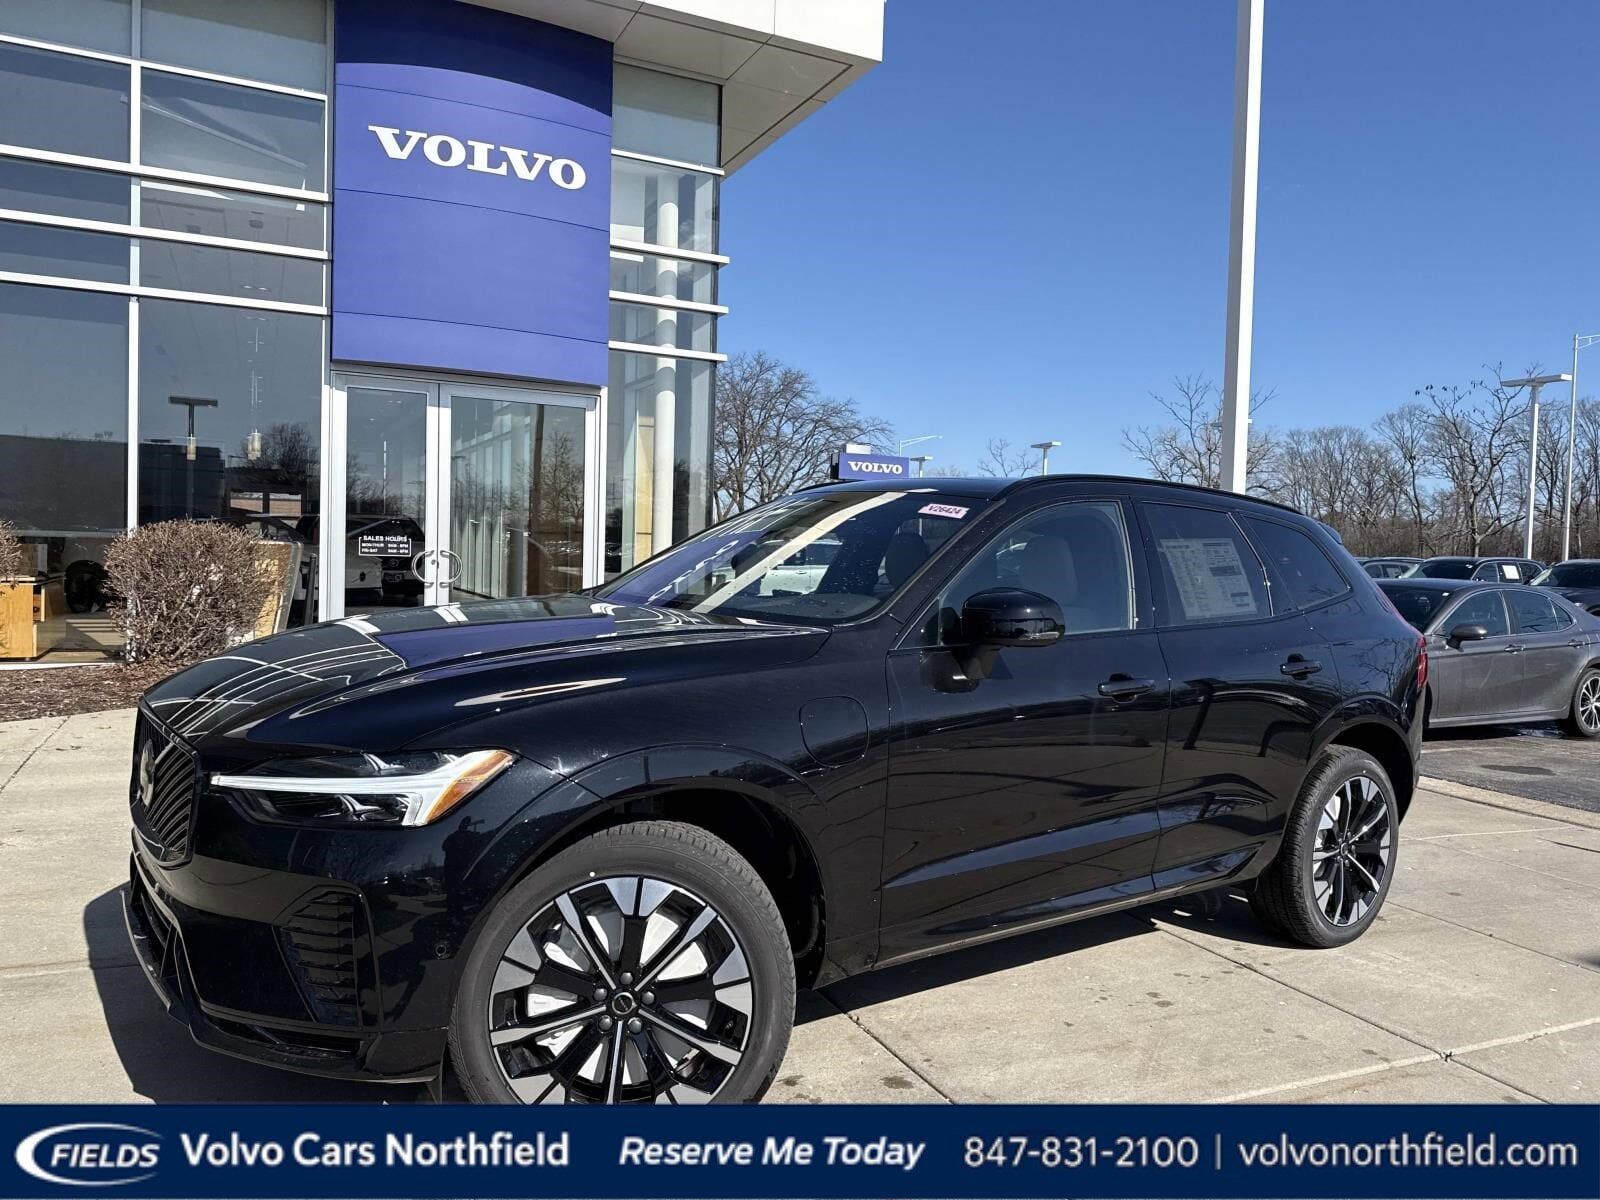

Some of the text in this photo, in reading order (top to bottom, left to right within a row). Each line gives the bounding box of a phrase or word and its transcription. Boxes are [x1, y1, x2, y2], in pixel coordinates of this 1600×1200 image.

[367, 125, 587, 191] VOLVO
[848, 461, 903, 475] VOLVO
[928, 505, 962, 515] V26424
